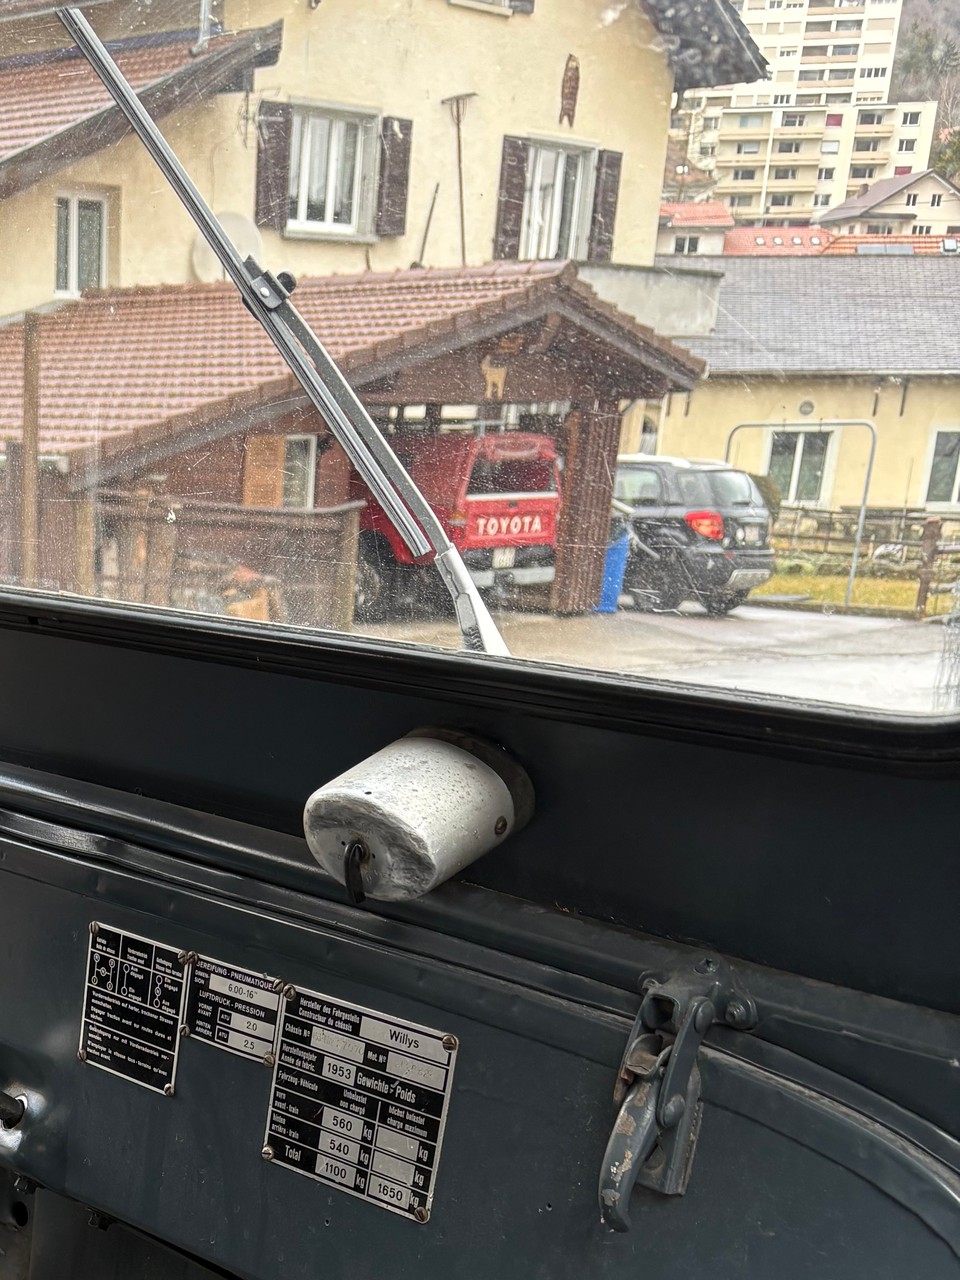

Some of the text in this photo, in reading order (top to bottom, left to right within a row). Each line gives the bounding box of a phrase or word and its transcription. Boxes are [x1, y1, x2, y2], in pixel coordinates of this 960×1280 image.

[477, 515, 542, 536] TOYOTA
[231, 972, 275, 991] PNEUMATIQUE
[200, 990, 231, 1006] LUFTDRUCK
[235, 1003, 266, 1017] PRESSION
[247, 1021, 257, 1031] 2.0
[244, 1040, 255, 1049] 2.5
[390, 1029, 420, 1048] Willys
[328, 1063, 352, 1080] 1953
[357, 1073, 389, 1093] Gewichte
[396, 1086, 416, 1103] Poids
[333, 1116, 372, 1140] 560 kg
[330, 1139, 369, 1165] 540 kg
[419, 1146, 428, 1162] kg
[285, 1145, 365, 1188] Total 1100 kg
[415, 1171, 424, 1186] kg
[378, 1184, 419, 1208] 1650 kg
